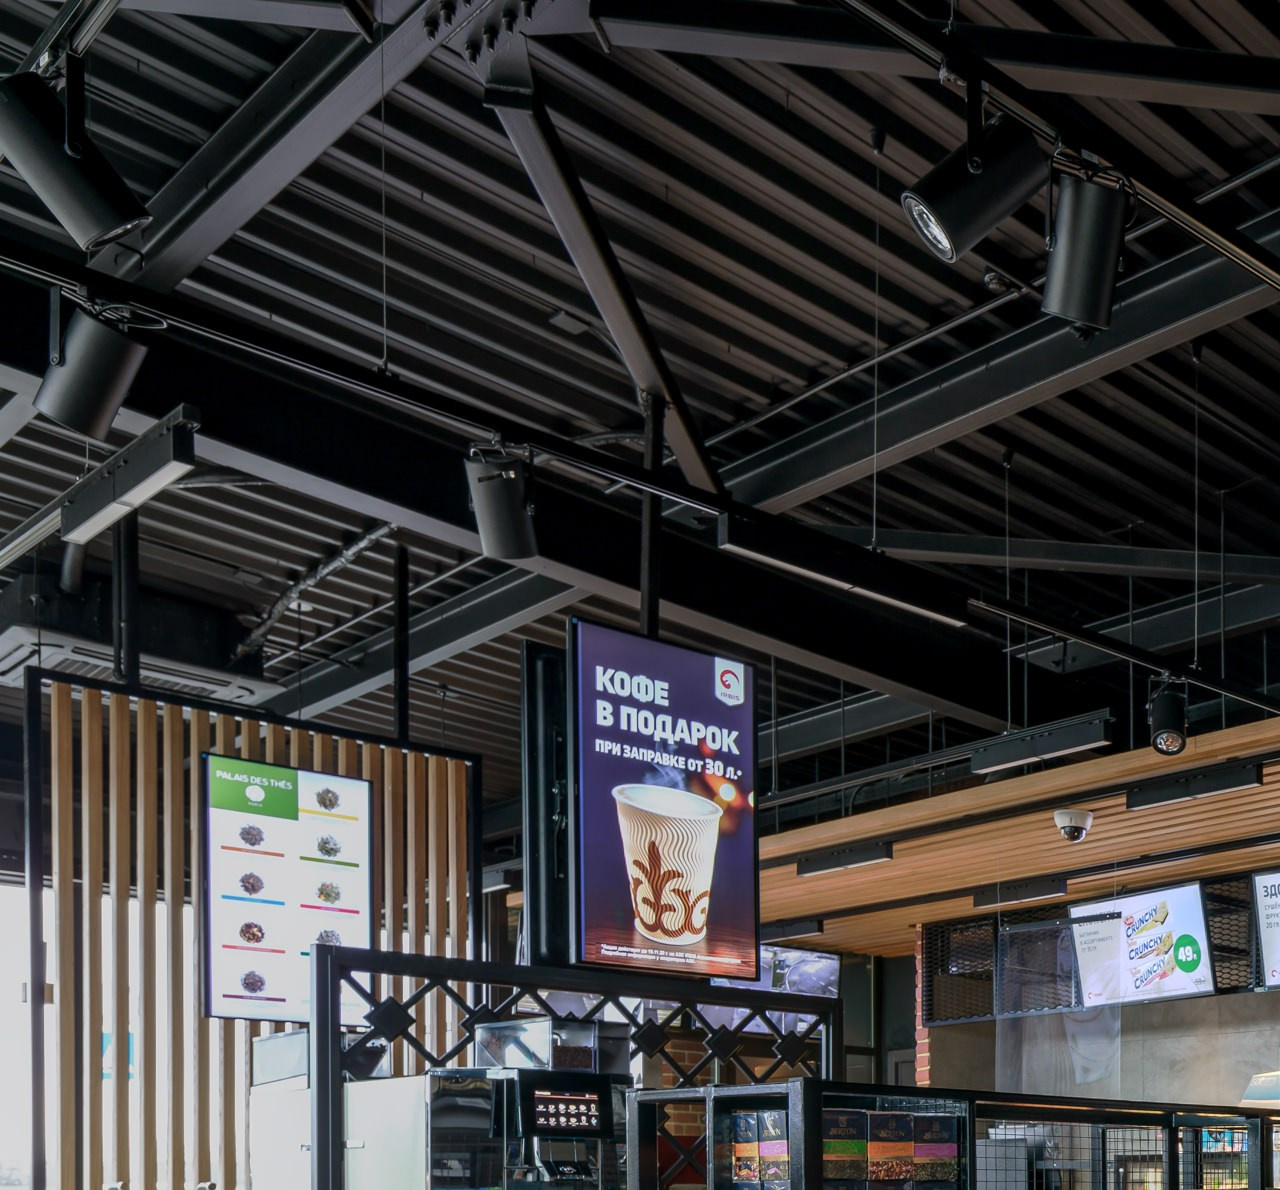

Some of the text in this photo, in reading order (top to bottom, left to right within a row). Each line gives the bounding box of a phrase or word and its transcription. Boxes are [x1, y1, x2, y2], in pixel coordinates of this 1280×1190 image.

[595, 665, 669, 707] КОФЕ
[596, 699, 740, 755] В ПОДАРОК
[595, 738, 621, 756] ПРИ
[622, 744, 686, 769] ЗАПРАВКЕ
[705, 758, 724, 778] 30
[215, 769, 293, 790] PALAIS DES THÉS
[1125, 905, 1158, 939] CRUNCHY
[1128, 935, 1164, 960] CRUNCHY
[1134, 956, 1166, 990] CRUNCHY
